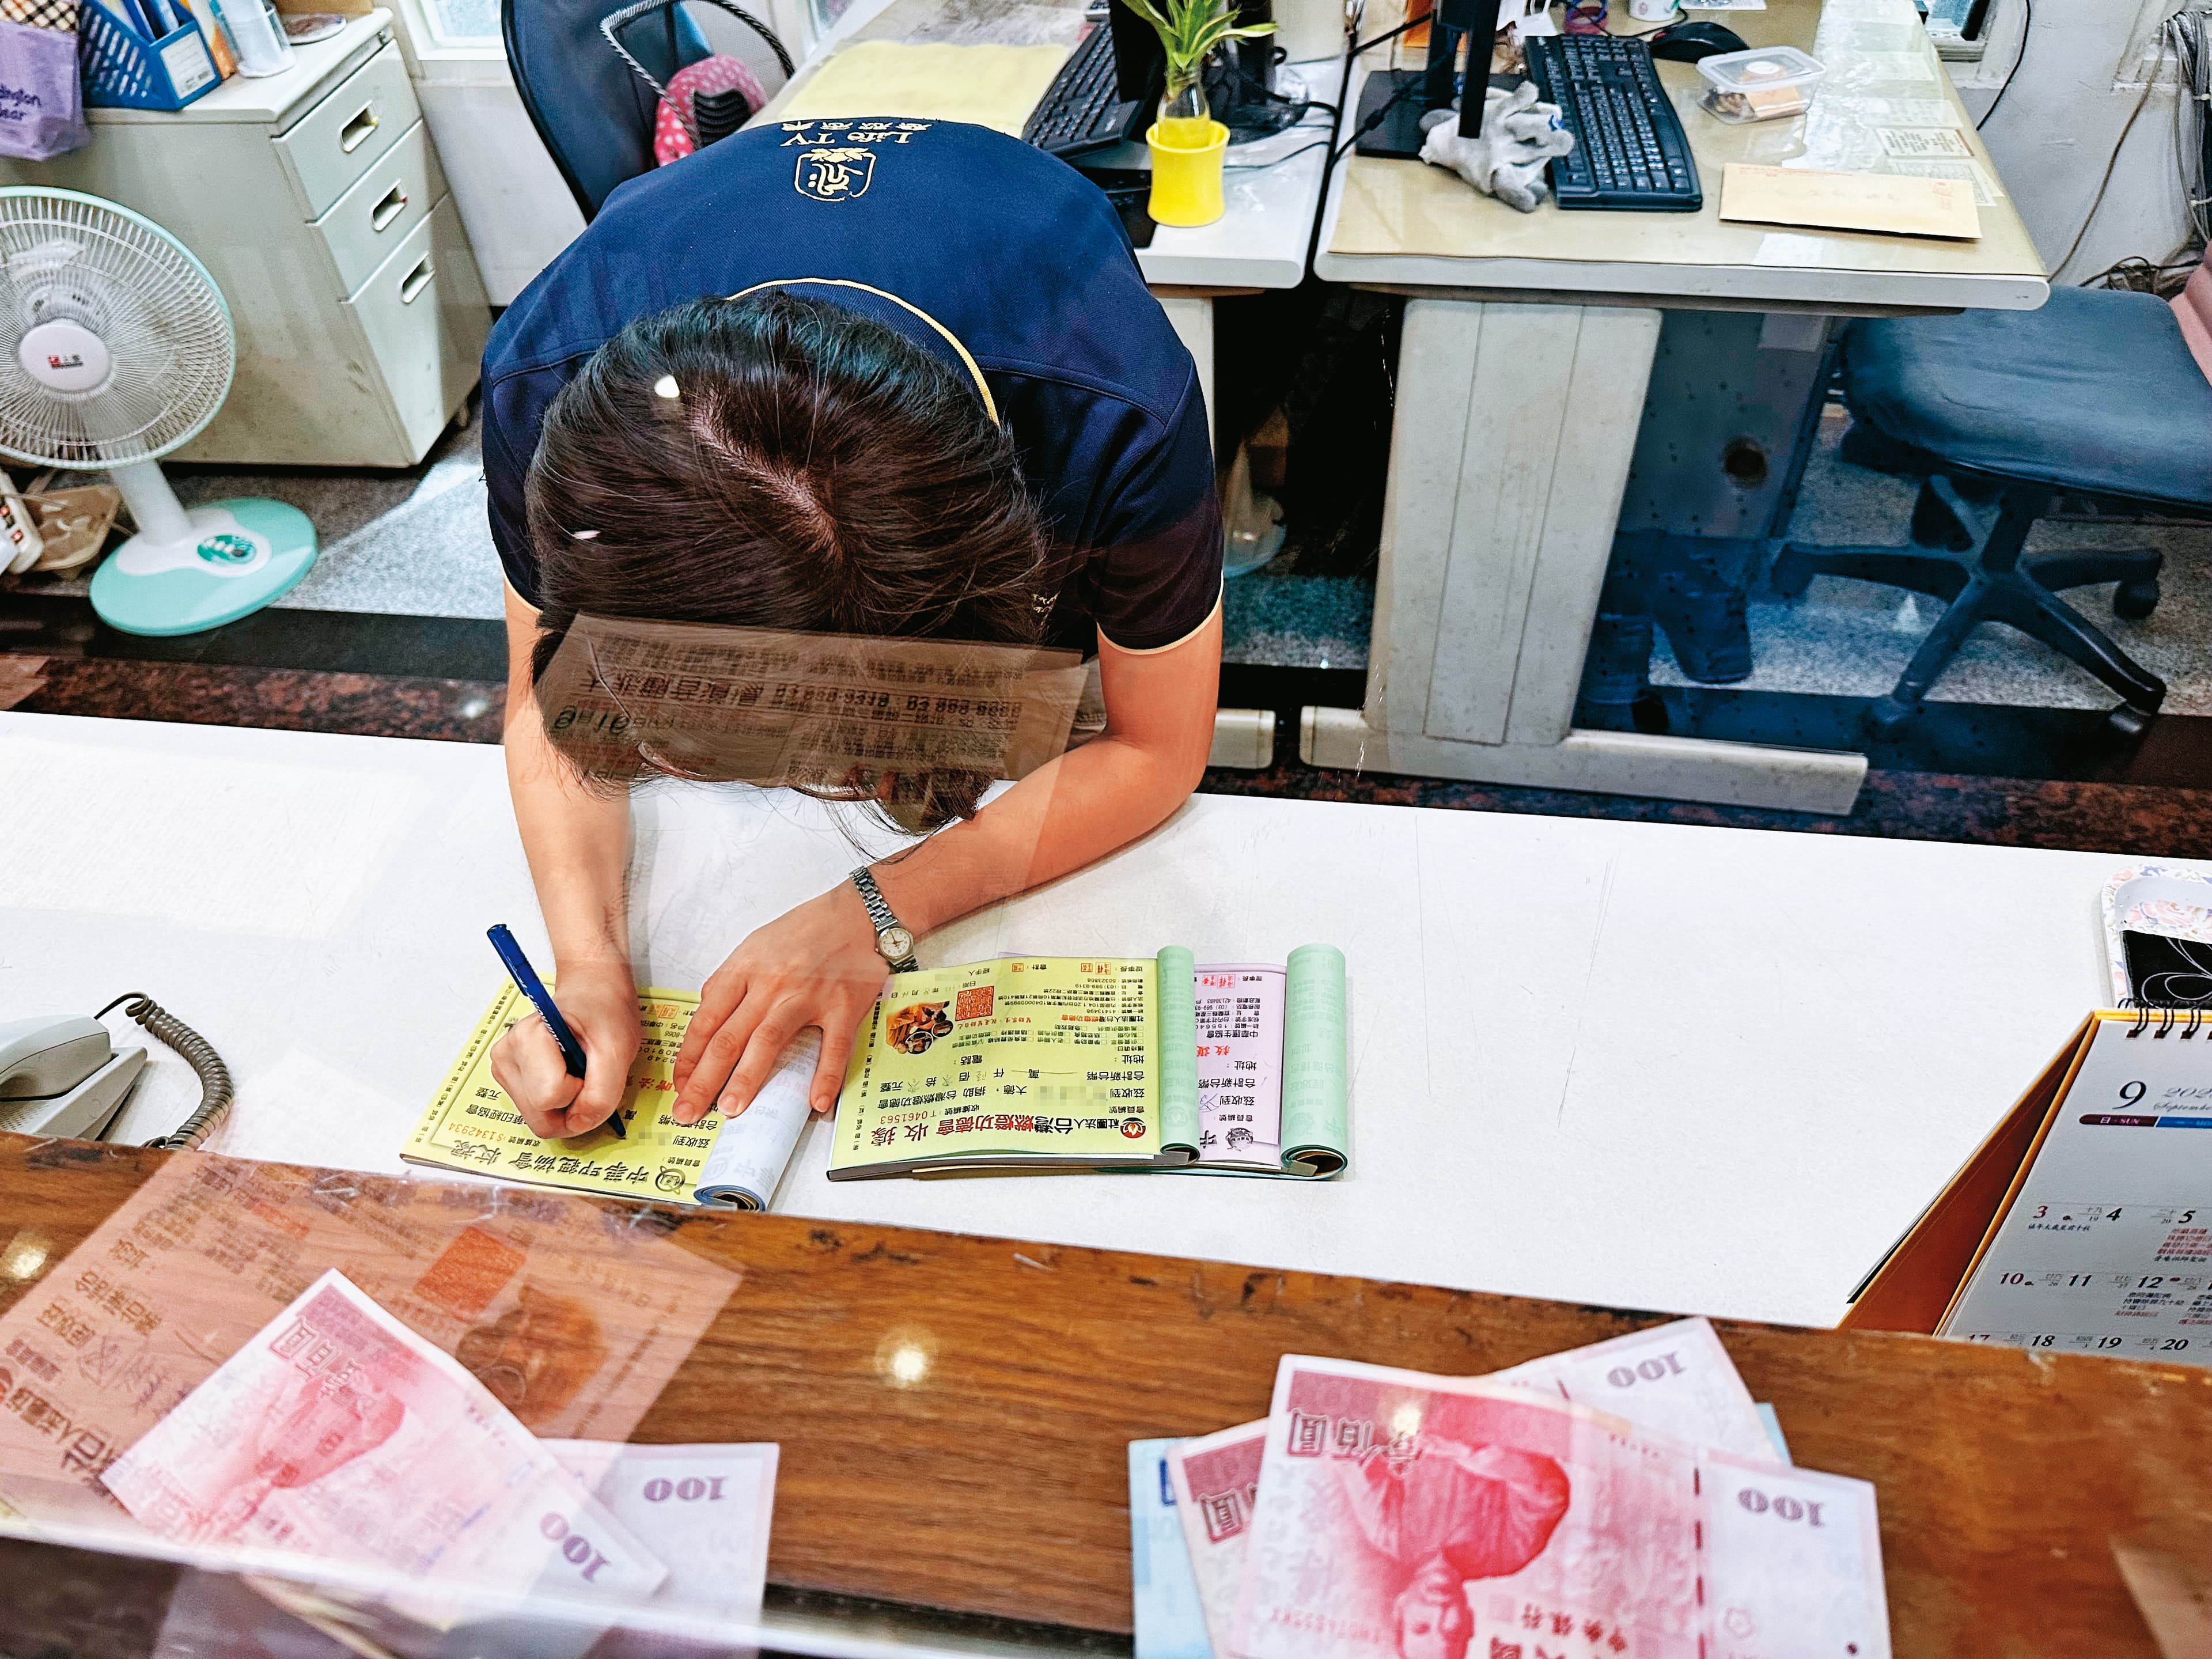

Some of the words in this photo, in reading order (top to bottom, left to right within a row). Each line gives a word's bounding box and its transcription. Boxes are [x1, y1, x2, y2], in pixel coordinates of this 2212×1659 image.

[780, 132, 835, 147] TV
[847, 132, 914, 145] Life
[1060, 1014, 1144, 1023] 社團法人台灣燃燈功德會
[1206, 1029, 1258, 1039] 中華護生協會
[959, 1071, 970, 1082] 佰
[993, 1067, 1005, 1078] 仟
[1028, 1069, 1040, 1080] 萬
[1086, 1070, 1145, 1081] 合計新台幣
[880, 1081, 904, 1093] 元整
[926, 1076, 937, 1088] 拾
[1197, 1077, 1256, 1089] 合計新台幣
[475, 1086, 502, 1101] 元整
[963, 1085, 986, 1098] 捐助
[1109, 1088, 1145, 1099] 茲收到
[2112, 1081, 2146, 1109] 9
[877, 1089, 957, 1109] 台灣燃燈功德會
[1219, 1095, 1255, 1106] 茲收到
[1108, 1105, 1145, 1113] 會員編號
[1218, 1114, 1253, 1122] 會員編號
[936, 1114, 1119, 1136] 社團法人台灣燃燈功德會
[870, 1123, 929, 1146] 收據
[672, 1134, 711, 1149] 茲收到
[507, 1152, 649, 1185] 中華印經協會
[2032, 1205, 2048, 1218] 3
[2106, 1207, 2122, 1221] 4
[2178, 1210, 2196, 1223] 5
[2000, 1272, 2024, 1285] 10
[2069, 1274, 2092, 1287] 11
[2138, 1275, 2164, 1289] 12
[2032, 1335, 2055, 1347] 18
[2098, 1337, 2123, 1349] 19
[2160, 1339, 2189, 1350] 20
[1606, 1351, 1684, 1389] 100
[642, 1475, 729, 1503] 100
[1737, 1487, 1825, 1529] 100
[539, 1512, 611, 1584] 100
